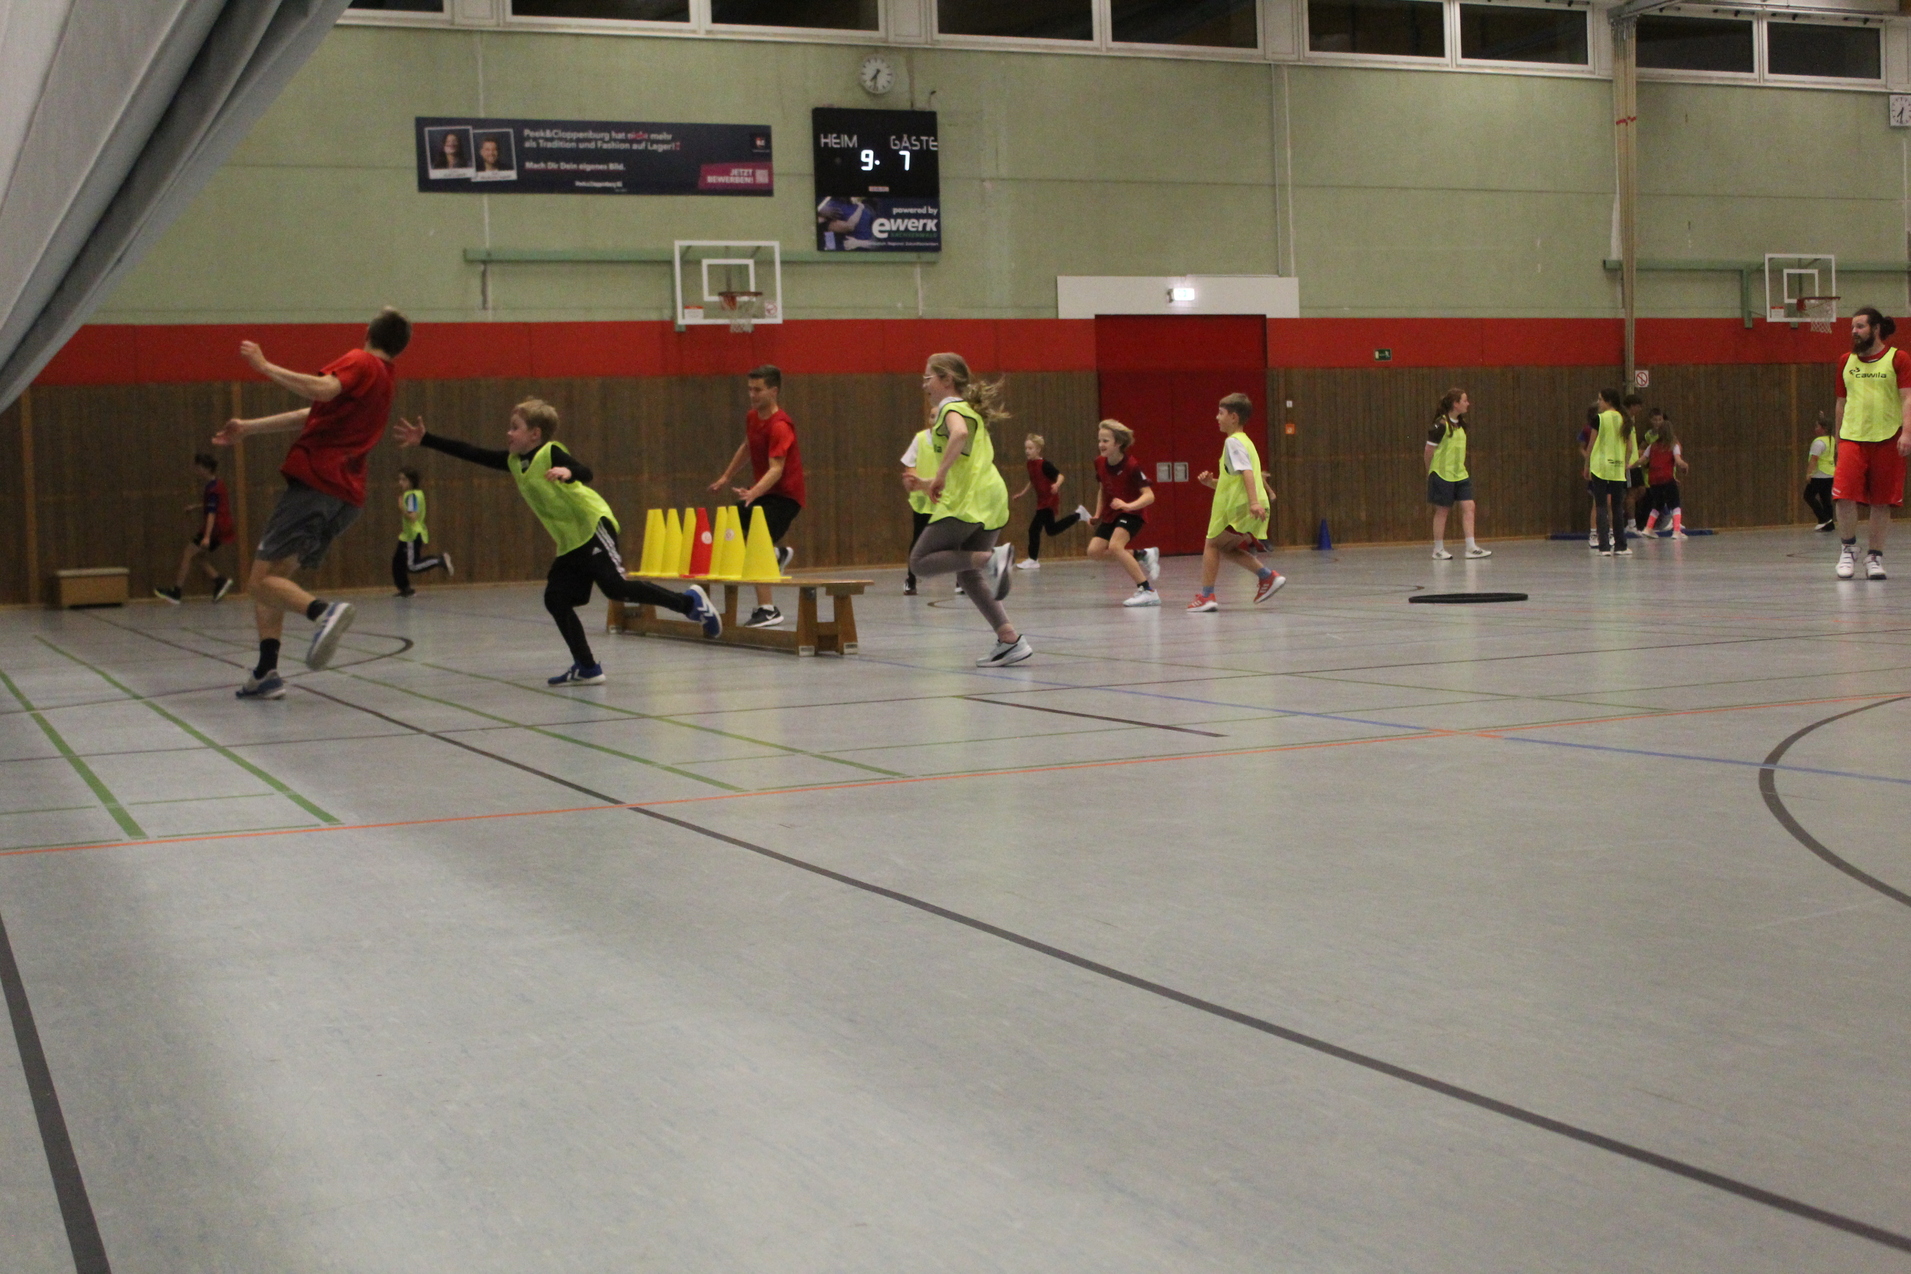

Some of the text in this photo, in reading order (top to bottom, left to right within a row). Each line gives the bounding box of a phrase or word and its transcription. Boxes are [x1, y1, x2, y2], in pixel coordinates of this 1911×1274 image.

[524, 129, 610, 141] Peek&Cloppenburg
[611, 131, 625, 140] hat
[649, 132, 672, 140] mehr
[524, 140, 537, 148] als
[539, 140, 577, 149] Tradition
[579, 141, 596, 149] und
[597, 141, 631, 150] Fashion
[632, 141, 646, 150] auf
[820, 133, 939, 151] HEIM GÄSTE
[898, 150, 911, 171] 7
[730, 168, 753, 176] JETZT
[892, 206, 938, 216] powered by
[872, 217, 939, 239] ewerk
